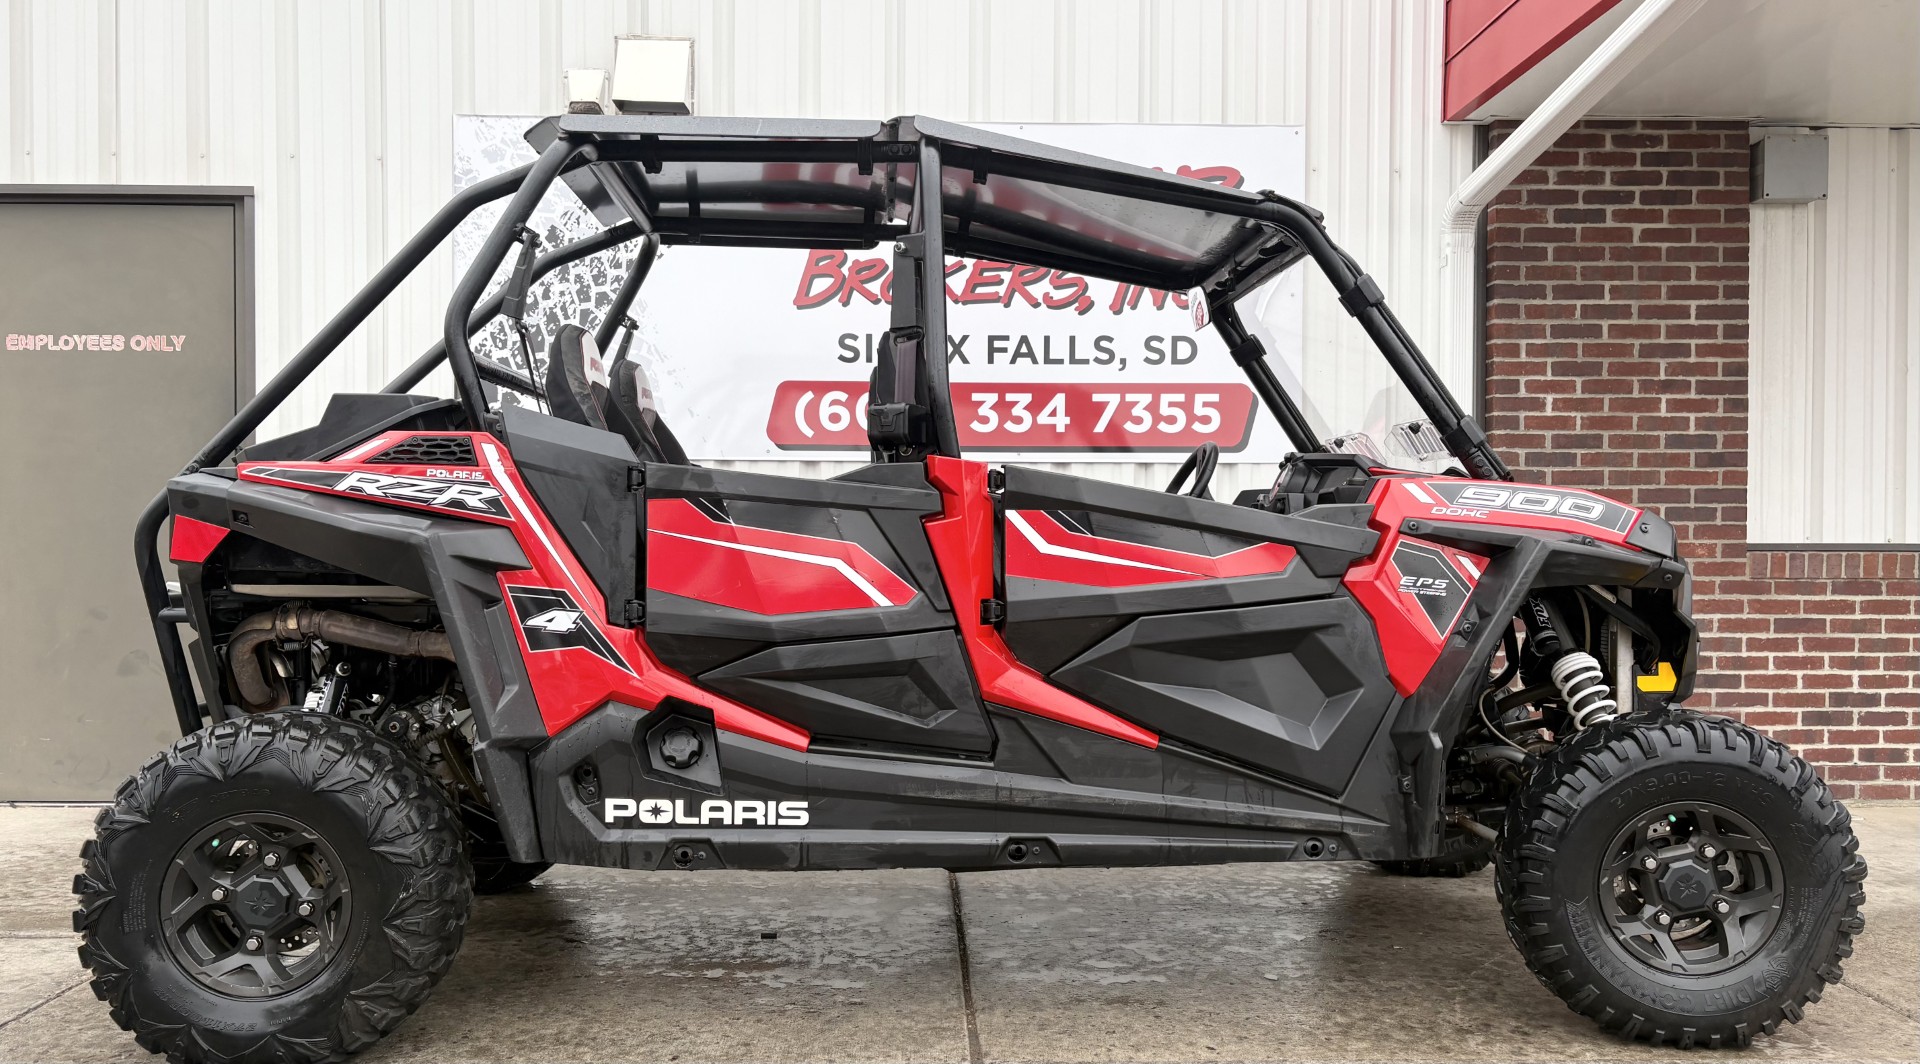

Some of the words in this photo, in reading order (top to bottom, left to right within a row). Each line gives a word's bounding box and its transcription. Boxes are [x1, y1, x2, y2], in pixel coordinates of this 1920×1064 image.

[6, 333, 125, 352] EMPLOYEES
[130, 334, 186, 352] ONLY
[837, 333, 970, 365] SIX
[987, 334, 1127, 371] FALLS,
[1143, 334, 1198, 365] SD
[969, 392, 1071, 433] 334
[1091, 392, 1221, 434] 7355
[426, 469, 485, 480] POLARIS
[332, 470, 504, 512] RZR
[1454, 485, 1605, 521] 900
[1430, 506, 1491, 519] DOHC
[1399, 576, 1449, 589] EPS
[524, 606, 585, 634] 4
[604, 798, 810, 826] POLARIS
